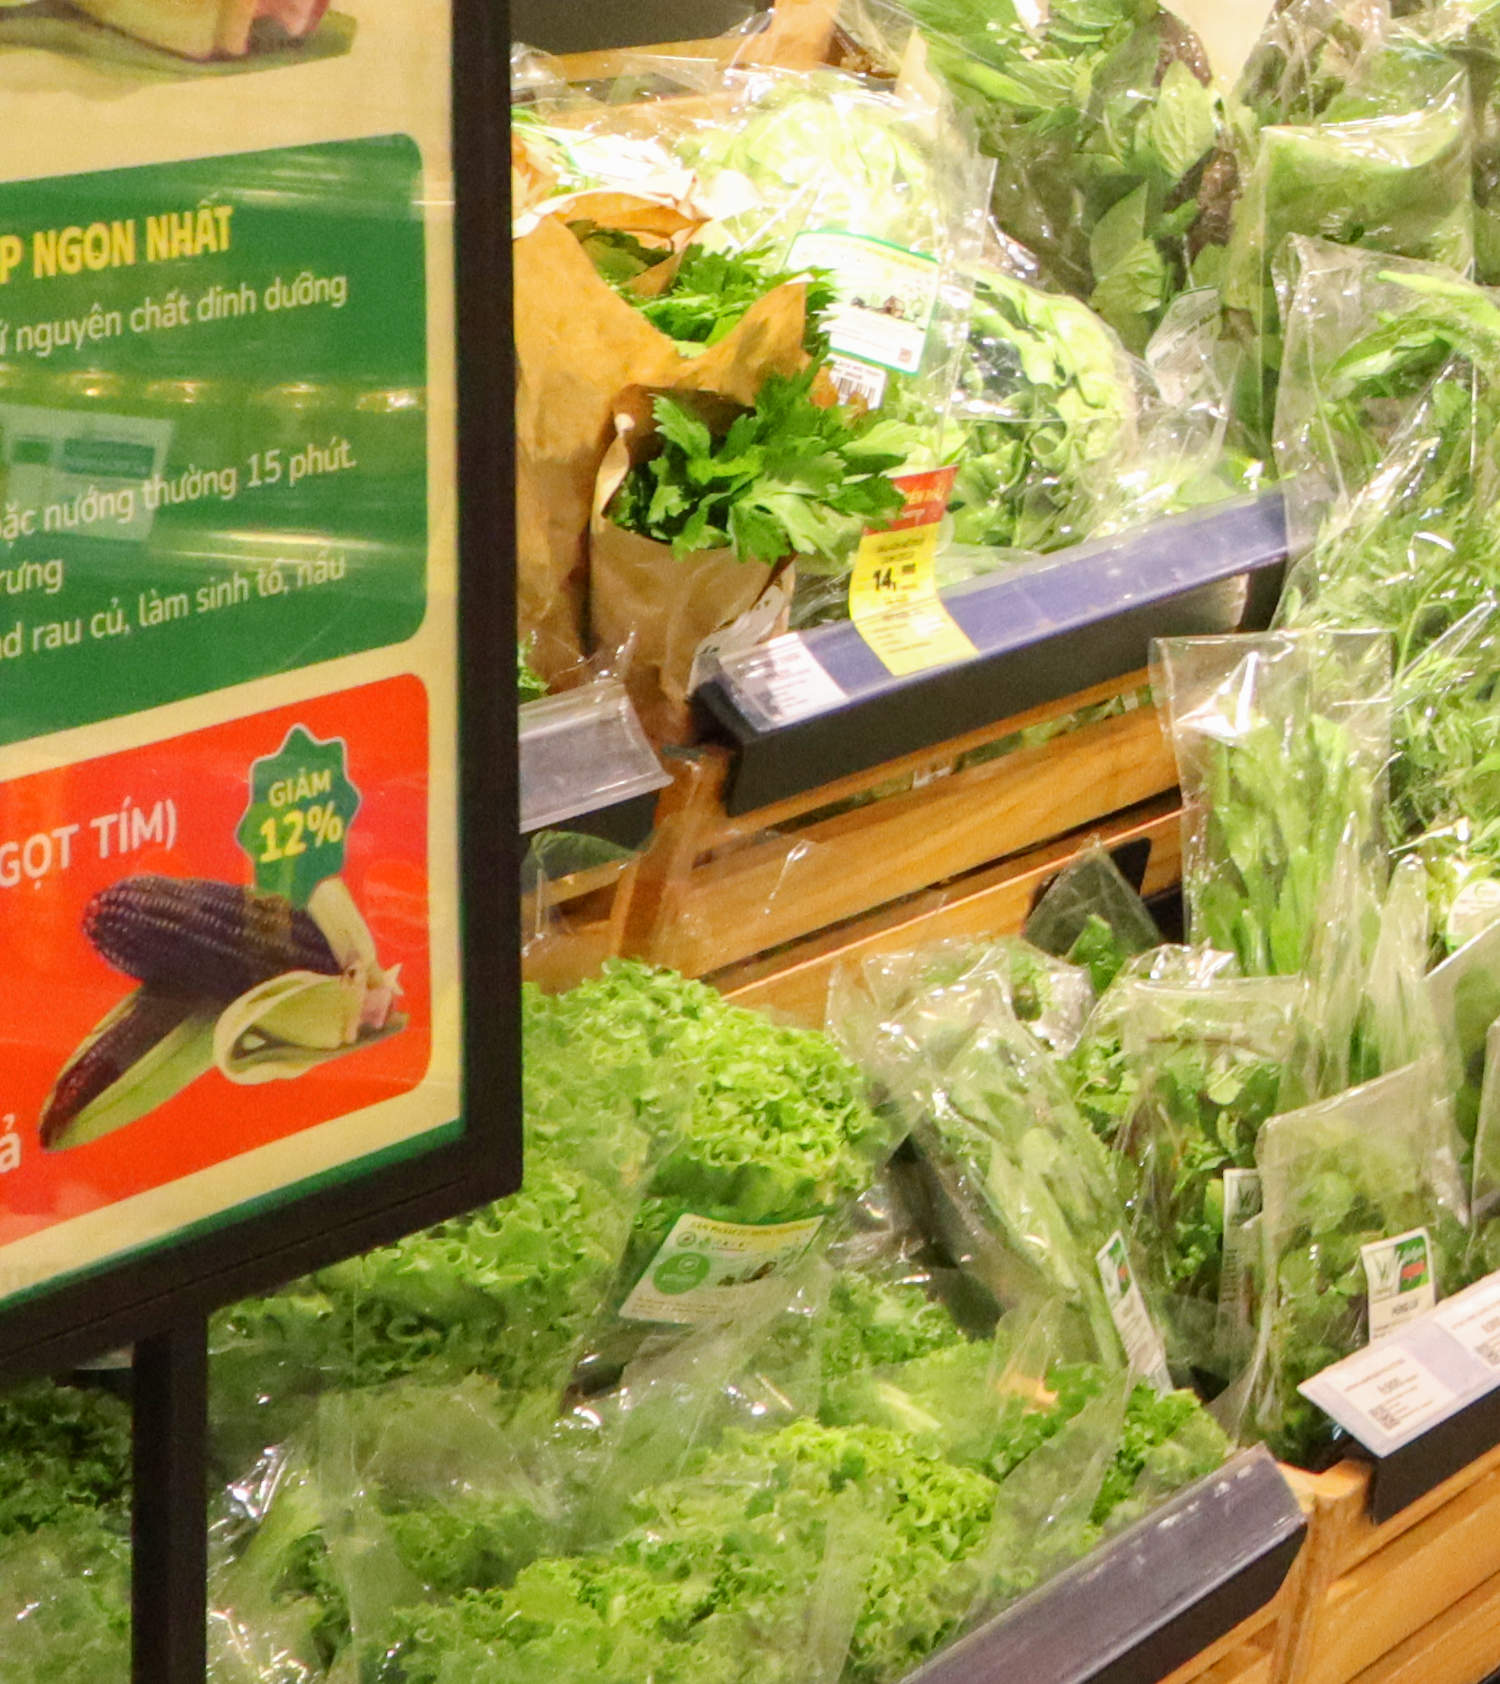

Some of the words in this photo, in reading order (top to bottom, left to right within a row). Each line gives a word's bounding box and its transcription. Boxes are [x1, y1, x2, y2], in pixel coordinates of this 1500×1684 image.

[146, 198, 234, 262] NHẤT
[248, 454, 281, 489] 15
[33, 617, 82, 649] rau
[139, 587, 189, 627] làm
[196, 573, 249, 613] sinh
[269, 767, 332, 808] GIẢM
[91, 796, 178, 859] TÍM)
[259, 802, 345, 864] 12%
